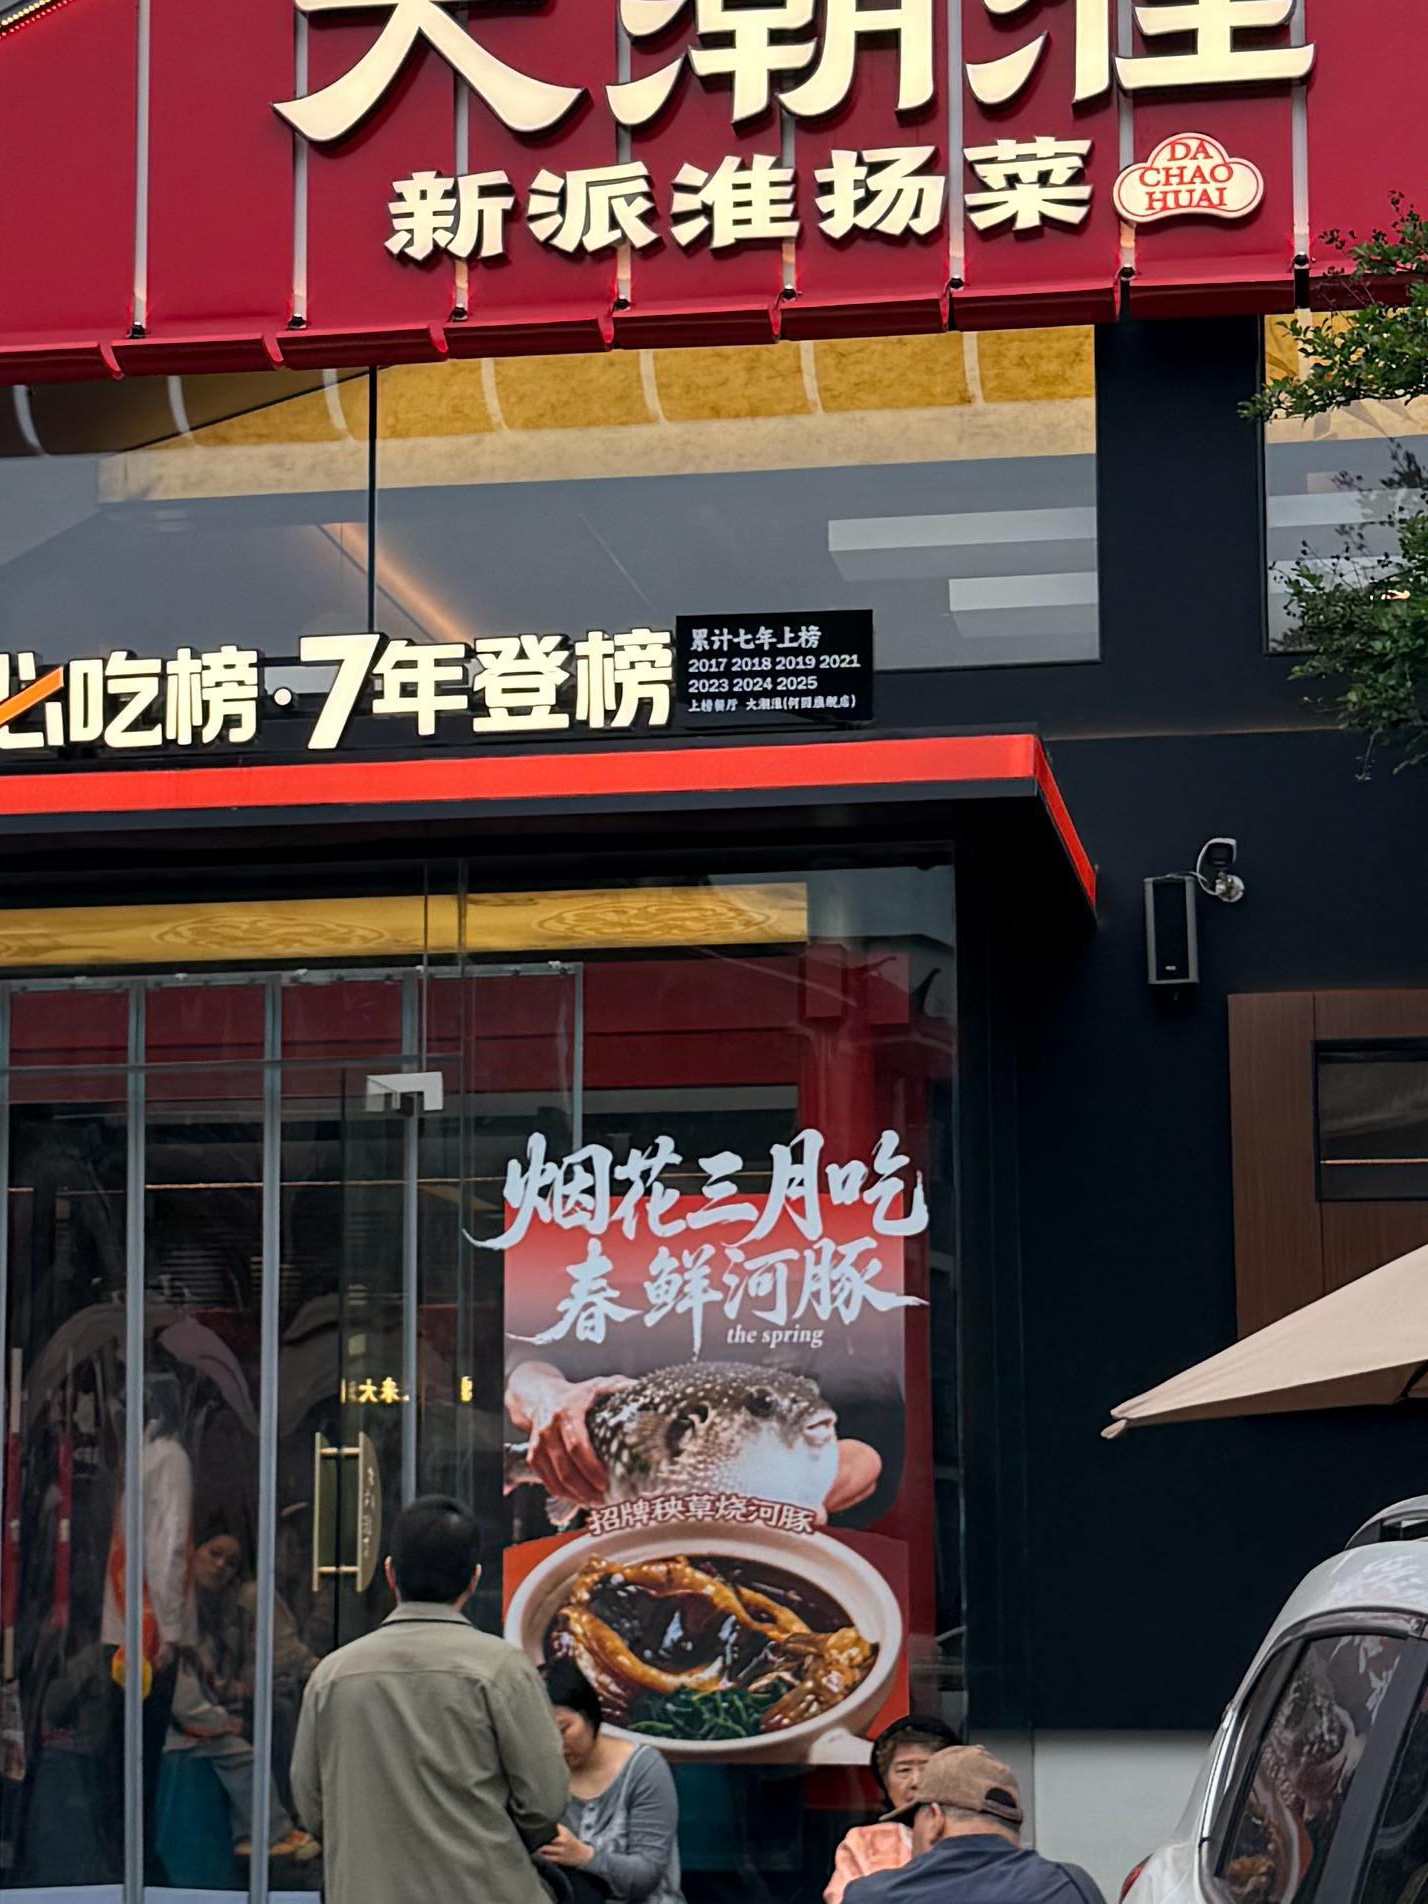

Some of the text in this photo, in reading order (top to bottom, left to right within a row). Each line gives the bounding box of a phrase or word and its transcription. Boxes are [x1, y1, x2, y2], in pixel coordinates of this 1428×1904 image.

[1167, 139, 1214, 162] DA
[1139, 163, 1234, 187] CHAO
[385, 136, 1092, 260] 新派淮扬菜
[1145, 187, 1228, 211] HUAI
[690, 625, 822, 651] 累计七年上榜
[688, 654, 861, 673] 2017 2018 2019 2021
[688, 675, 818, 693] 2023 2024 2025
[463, 1128, 929, 1250] 烟花三月吃
[504, 1238, 929, 1362] 春鲜河豚
[726, 1323, 825, 1349] the spring
[587, 1494, 816, 1536] 招牌秧草烧河豚
